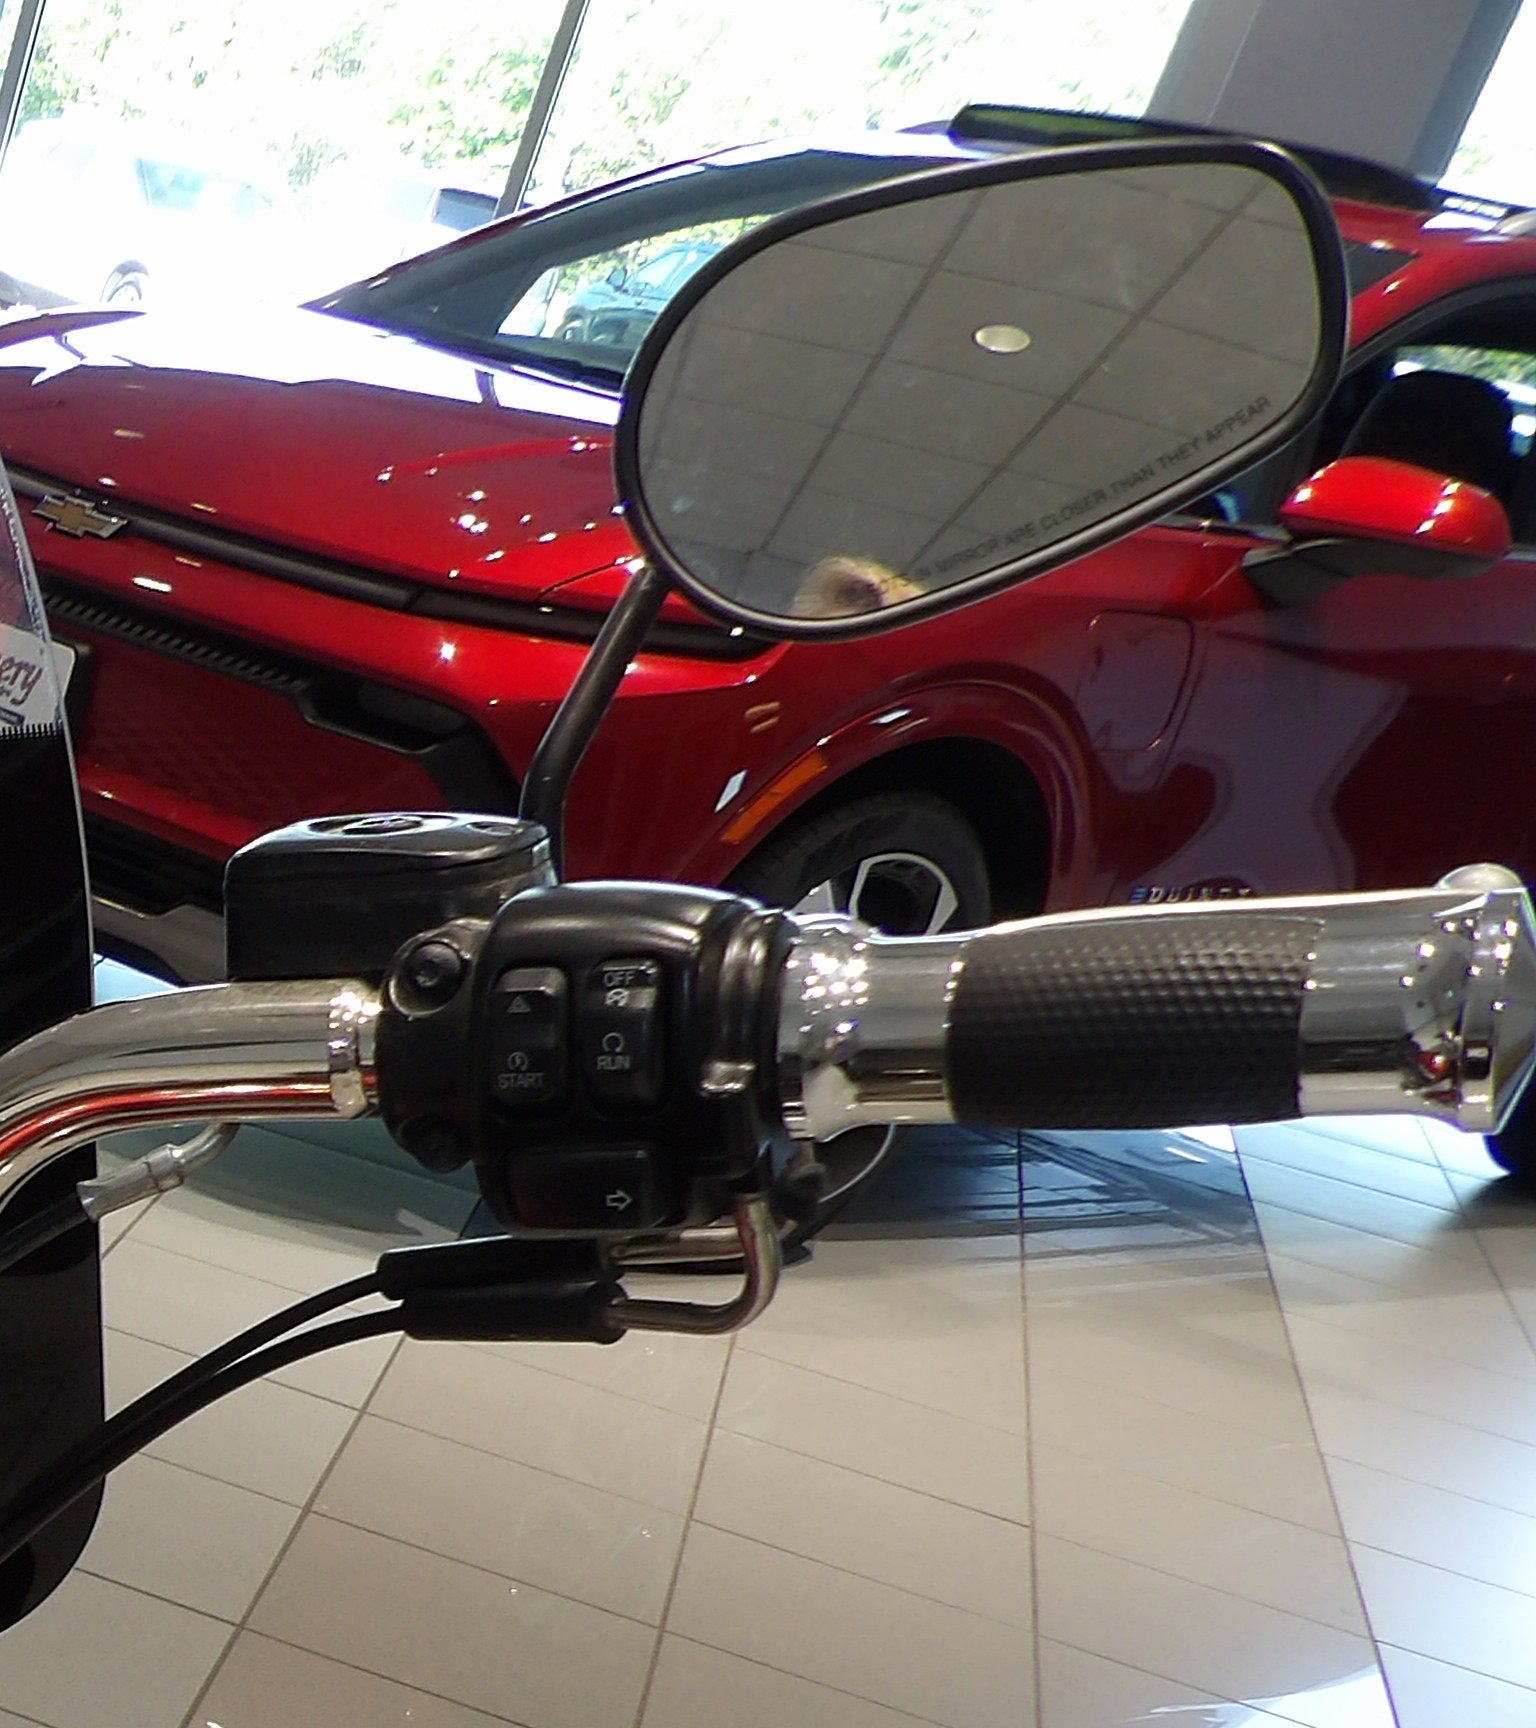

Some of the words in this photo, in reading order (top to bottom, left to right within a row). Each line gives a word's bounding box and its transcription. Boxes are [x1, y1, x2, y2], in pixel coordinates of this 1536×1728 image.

[1006, 523, 1036, 546] ARE
[1039, 488, 1108, 532] CLOSER
[1110, 464, 1157, 494] THAN
[1156, 436, 1202, 470] THEY
[1204, 396, 1271, 443] APPEAR
[603, 971, 635, 987] OFF
[596, 1055, 630, 1070] RUN
[497, 1072, 544, 1089] START
